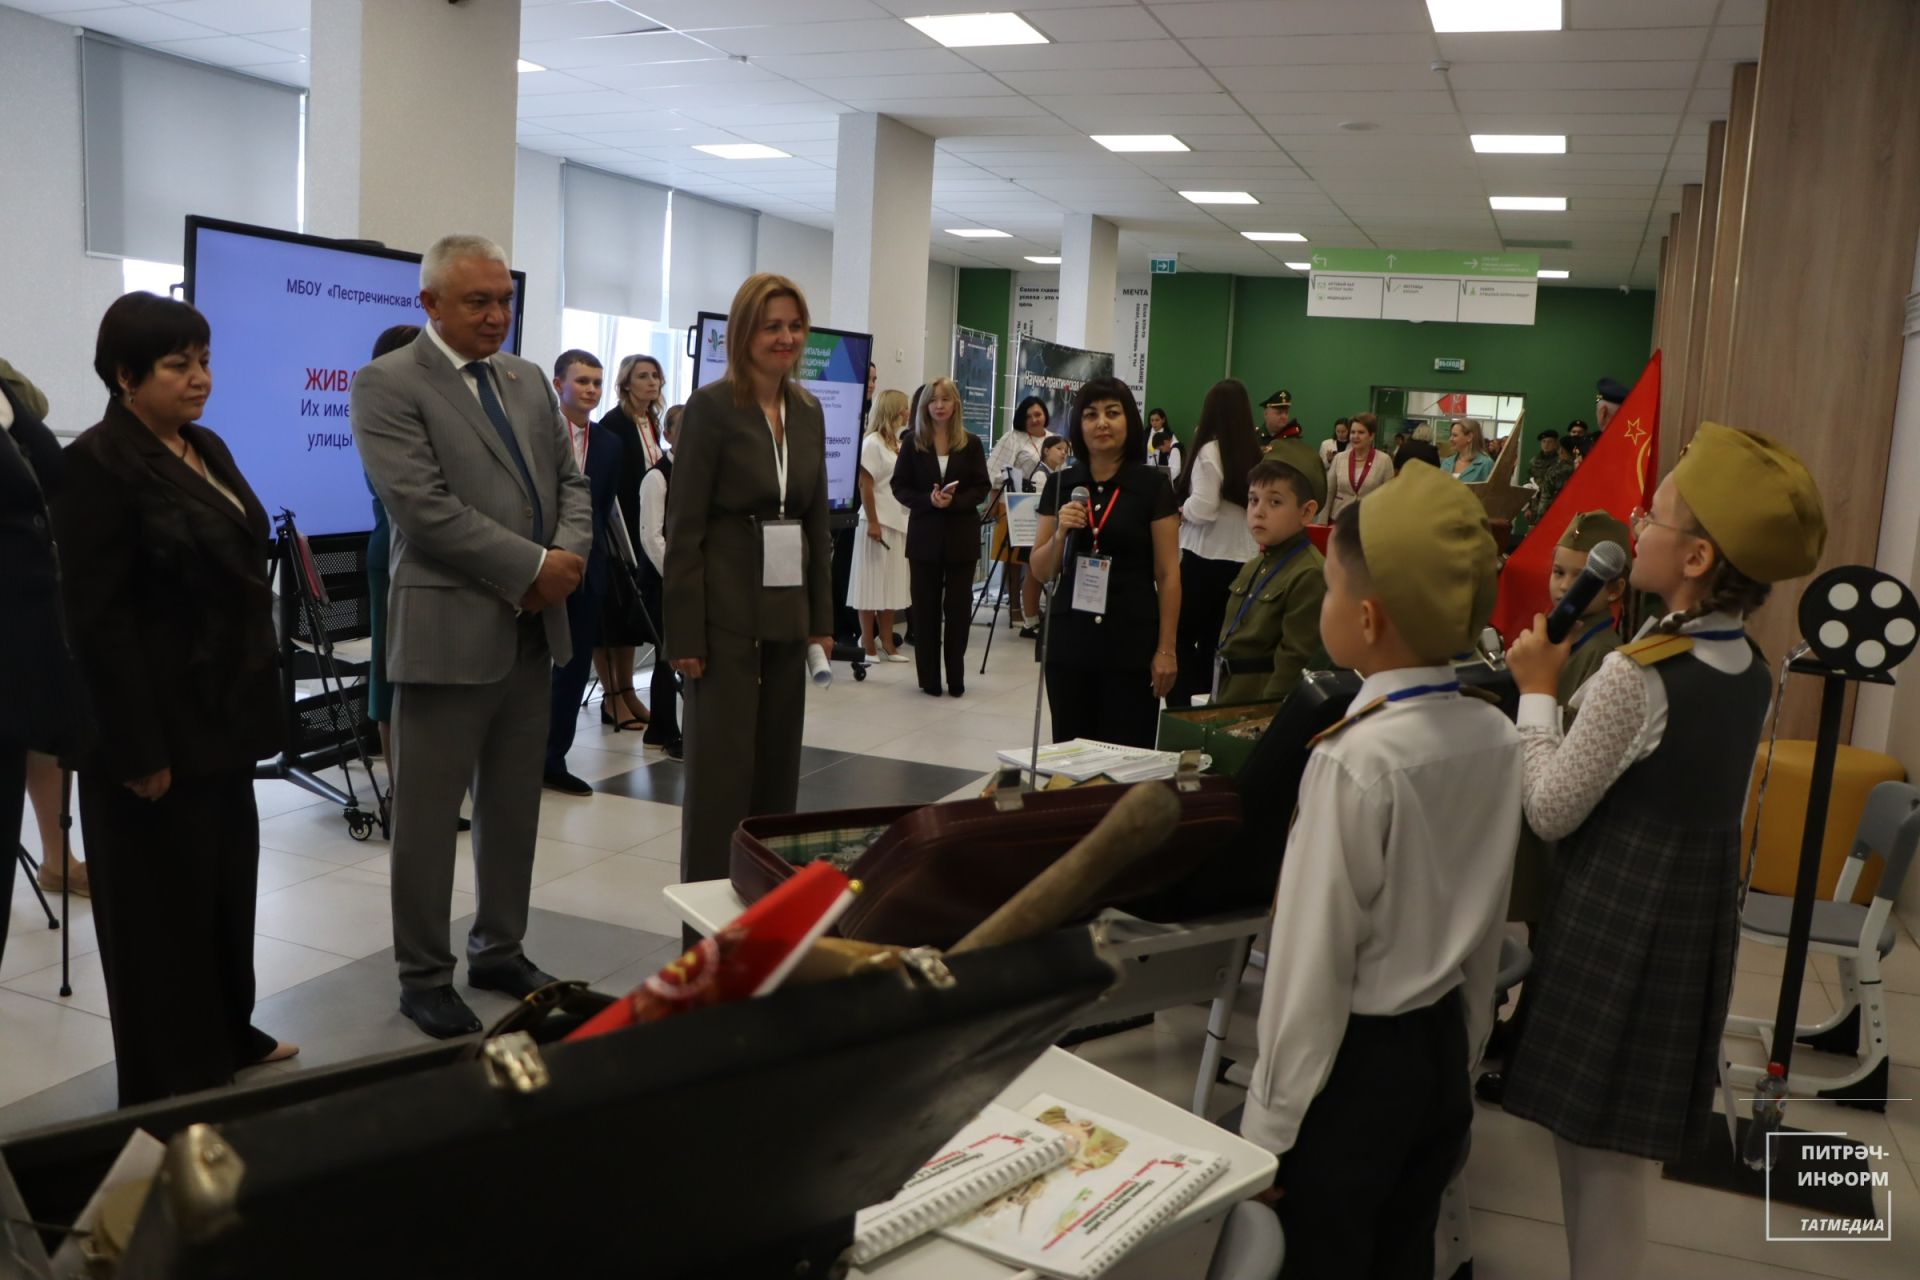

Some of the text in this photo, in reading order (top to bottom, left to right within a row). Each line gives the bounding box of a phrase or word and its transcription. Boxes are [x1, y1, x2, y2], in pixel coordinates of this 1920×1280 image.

[286, 278, 322, 297] МБОУ
[327, 284, 412, 309] «Пестречинская
[1439, 360, 1460, 368] ВЫХОД
[300, 398, 320, 417] Их
[308, 433, 352, 452] улицы
